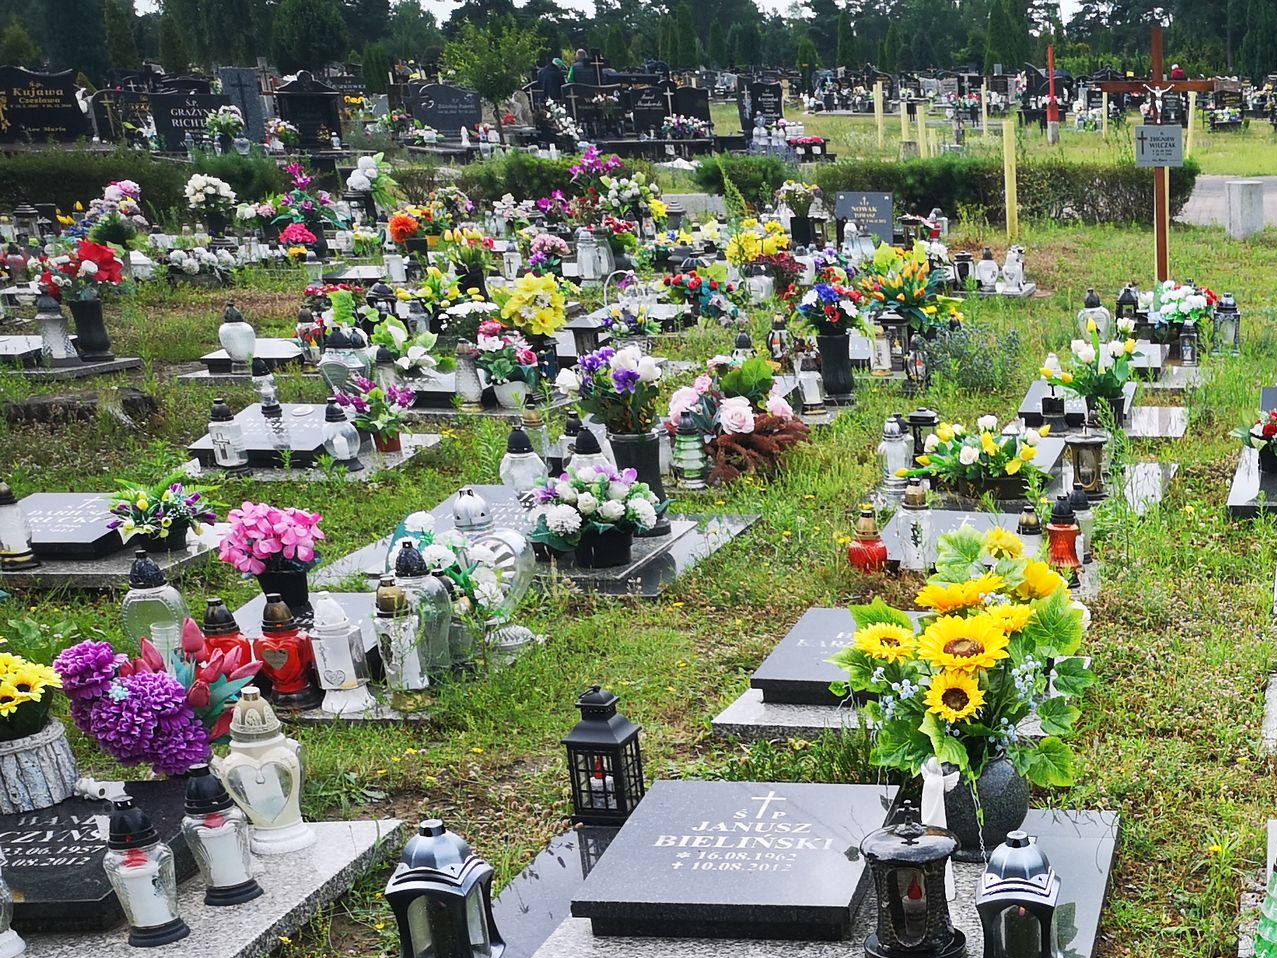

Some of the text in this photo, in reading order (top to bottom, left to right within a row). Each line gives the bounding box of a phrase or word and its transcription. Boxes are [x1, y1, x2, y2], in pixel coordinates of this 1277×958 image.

[12, 87, 64, 98] Kujawa
[171, 107, 209, 116] GRAŻYN
[691, 821, 813, 833] JANUSZ
[654, 833, 834, 849] BIELIŃSKI
[697, 851, 797, 861] 16.08.1962
[691, 862, 793, 872] 10.08.2012
